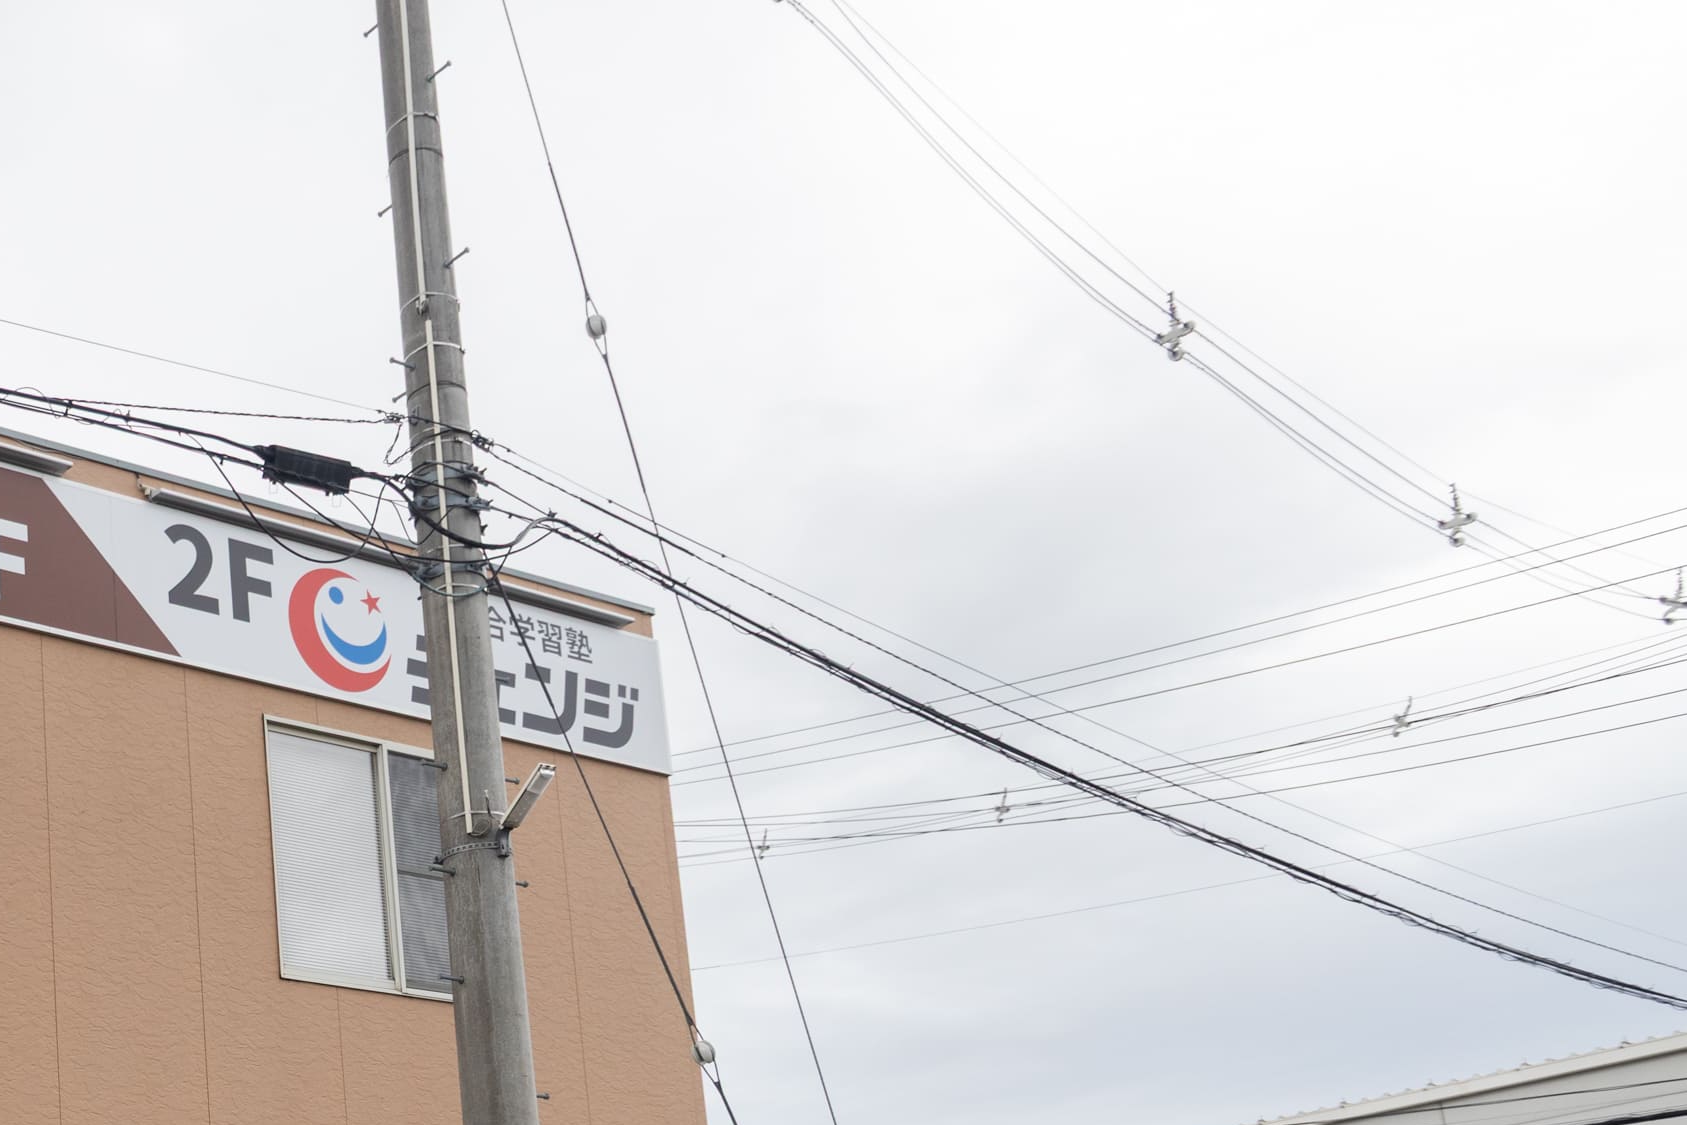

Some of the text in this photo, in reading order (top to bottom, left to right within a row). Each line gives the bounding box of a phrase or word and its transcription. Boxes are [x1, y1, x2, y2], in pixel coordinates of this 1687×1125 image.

[164, 523, 274, 623] 2F
[488, 606, 593, 664] 合学習塾
